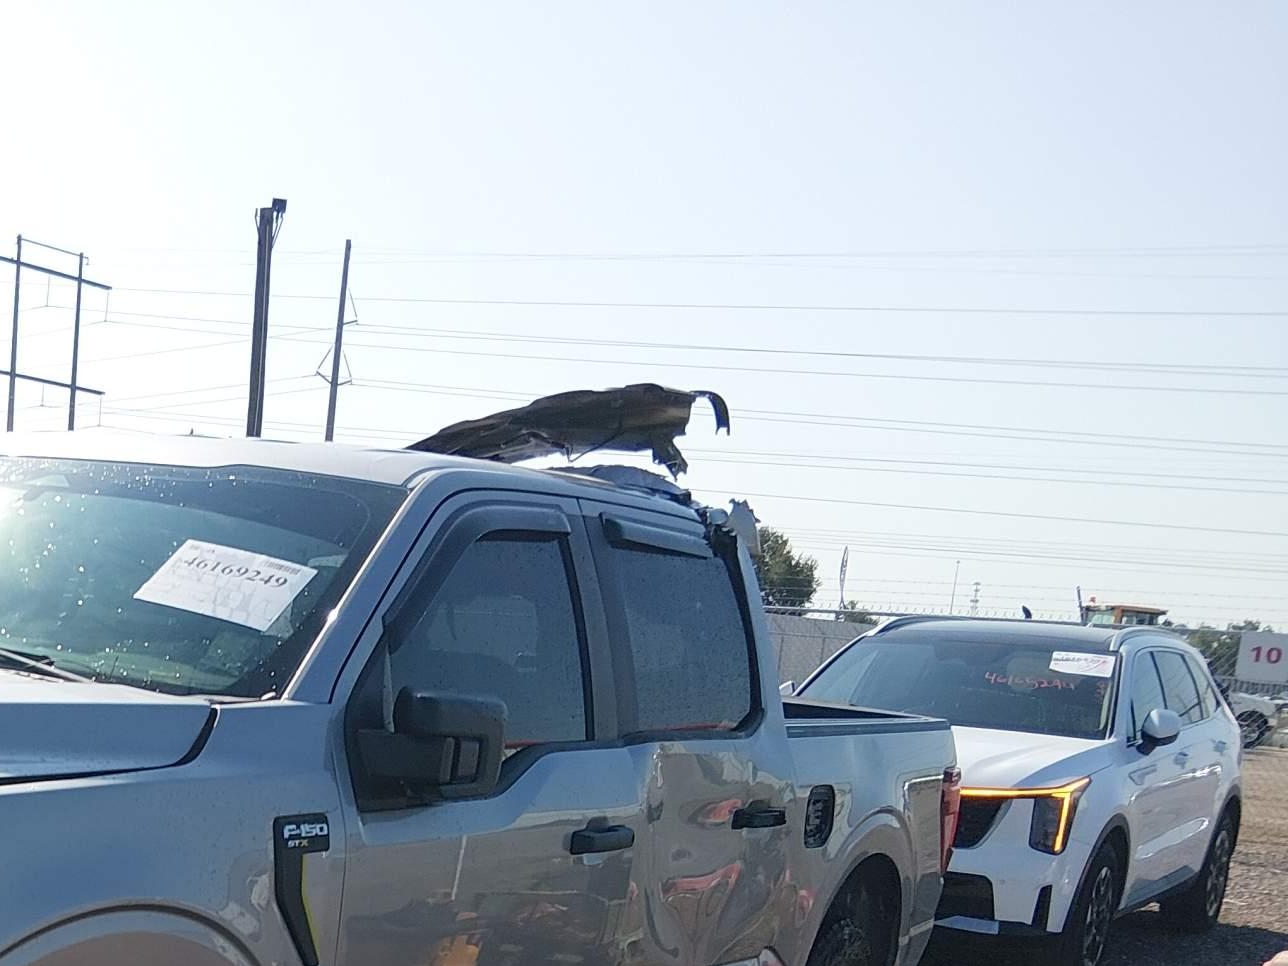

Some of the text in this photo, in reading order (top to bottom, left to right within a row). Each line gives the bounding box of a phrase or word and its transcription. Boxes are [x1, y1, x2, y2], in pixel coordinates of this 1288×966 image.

[183, 556, 288, 588] 46169249
[1250, 646, 1282, 664] 10
[283, 823, 328, 839] F-150
